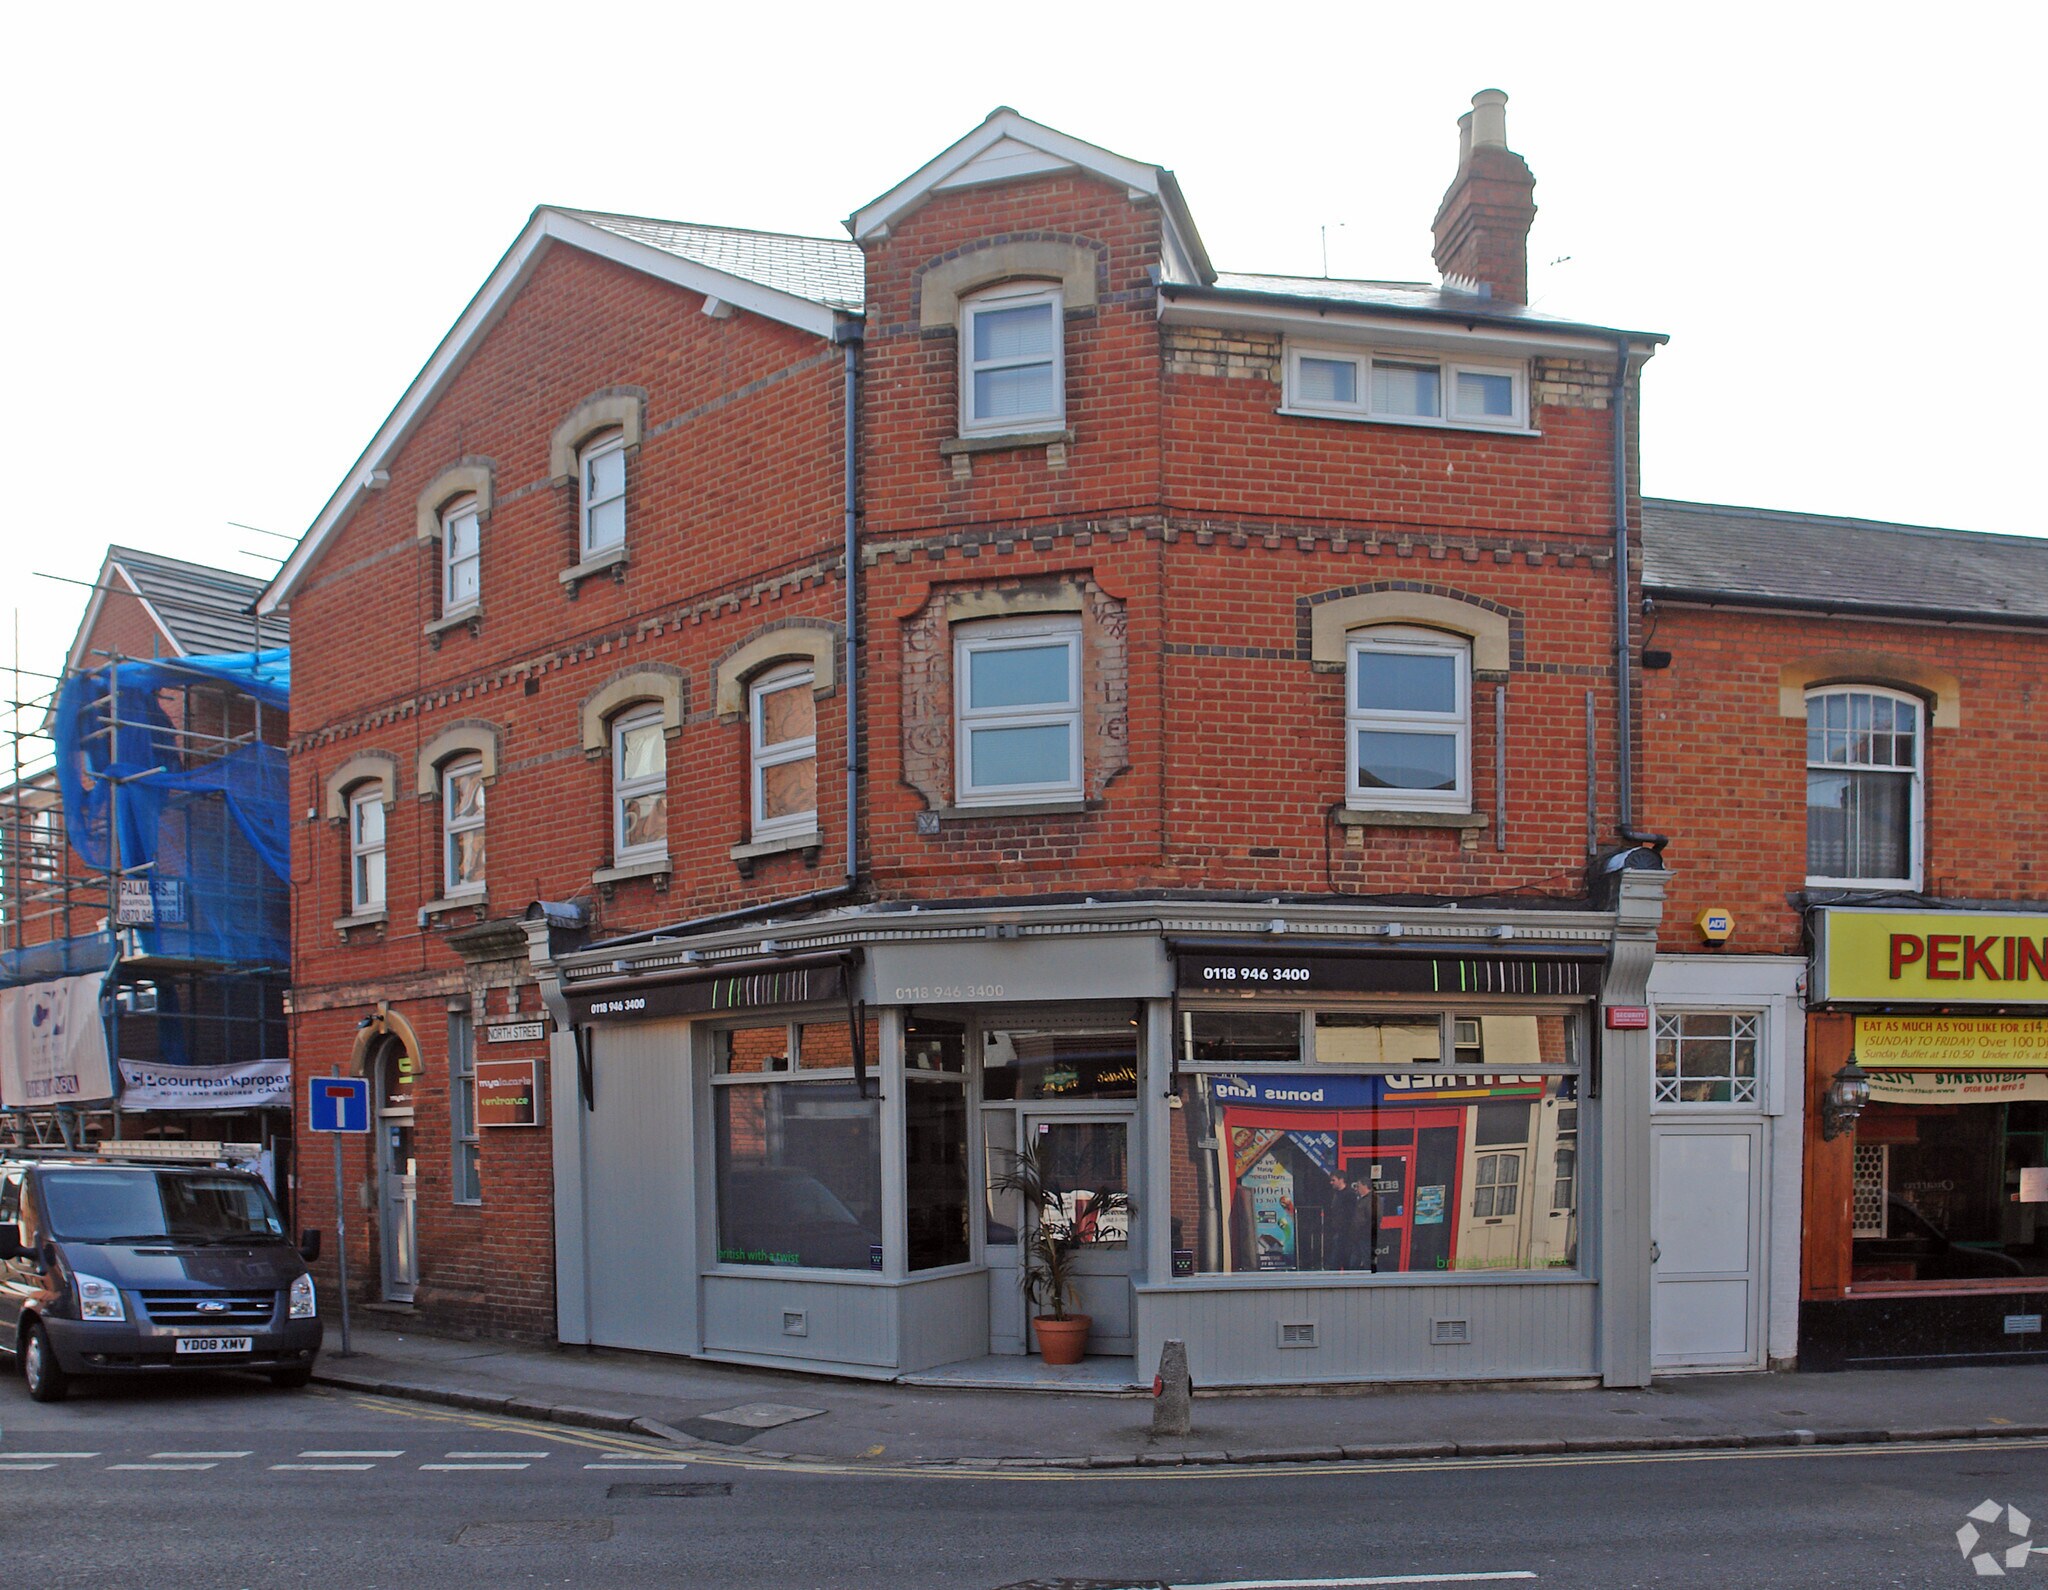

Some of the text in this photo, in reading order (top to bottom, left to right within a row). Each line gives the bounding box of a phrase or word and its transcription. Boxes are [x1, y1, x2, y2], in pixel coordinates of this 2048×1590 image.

[121, 882, 167, 895] PALMRS
[1709, 918, 1726, 929] ADT
[1889, 933, 2048, 981] PEKIN
[1203, 967, 1310, 981] 0118 946 3400
[895, 984, 1004, 1000] 0118 946 3400
[591, 998, 646, 1014] 0118 946 3400
[488, 1025, 542, 1040] NORTH STREET
[1863, 1021, 1882, 1032] EAT
[1885, 1021, 1899, 1032] AS
[1901, 1021, 1933, 1032] MUCH
[1936, 1022, 1949, 1032] AS
[1952, 1022, 1973, 1032] YOU
[1977, 1022, 1997, 1033] LIKE
[2000, 1022, 2019, 1033] FOR
[1865, 1035, 1916, 1046] (SUNDAY
[1918, 1036, 1933, 1046] TO
[1935, 1036, 1975, 1047] FRIDAY)
[1978, 1036, 2007, 1047] Over
[2013, 1036, 2034, 1047] 100
[1864, 1049, 1898, 1060] Sunday
[1900, 1049, 1928, 1059] Buffet
[1930, 1051, 1939, 1059] at
[1982, 1049, 2009, 1059] Under
[2032, 1051, 2041, 1059] at
[485, 1096, 529, 1105] entrance
[748, 1248, 767, 1261] with
[769, 1253, 775, 1262] a
[776, 1251, 799, 1263] twist
[1436, 1255, 1483, 1269] british
[183, 1338, 246, 1351] YD08 XMV
